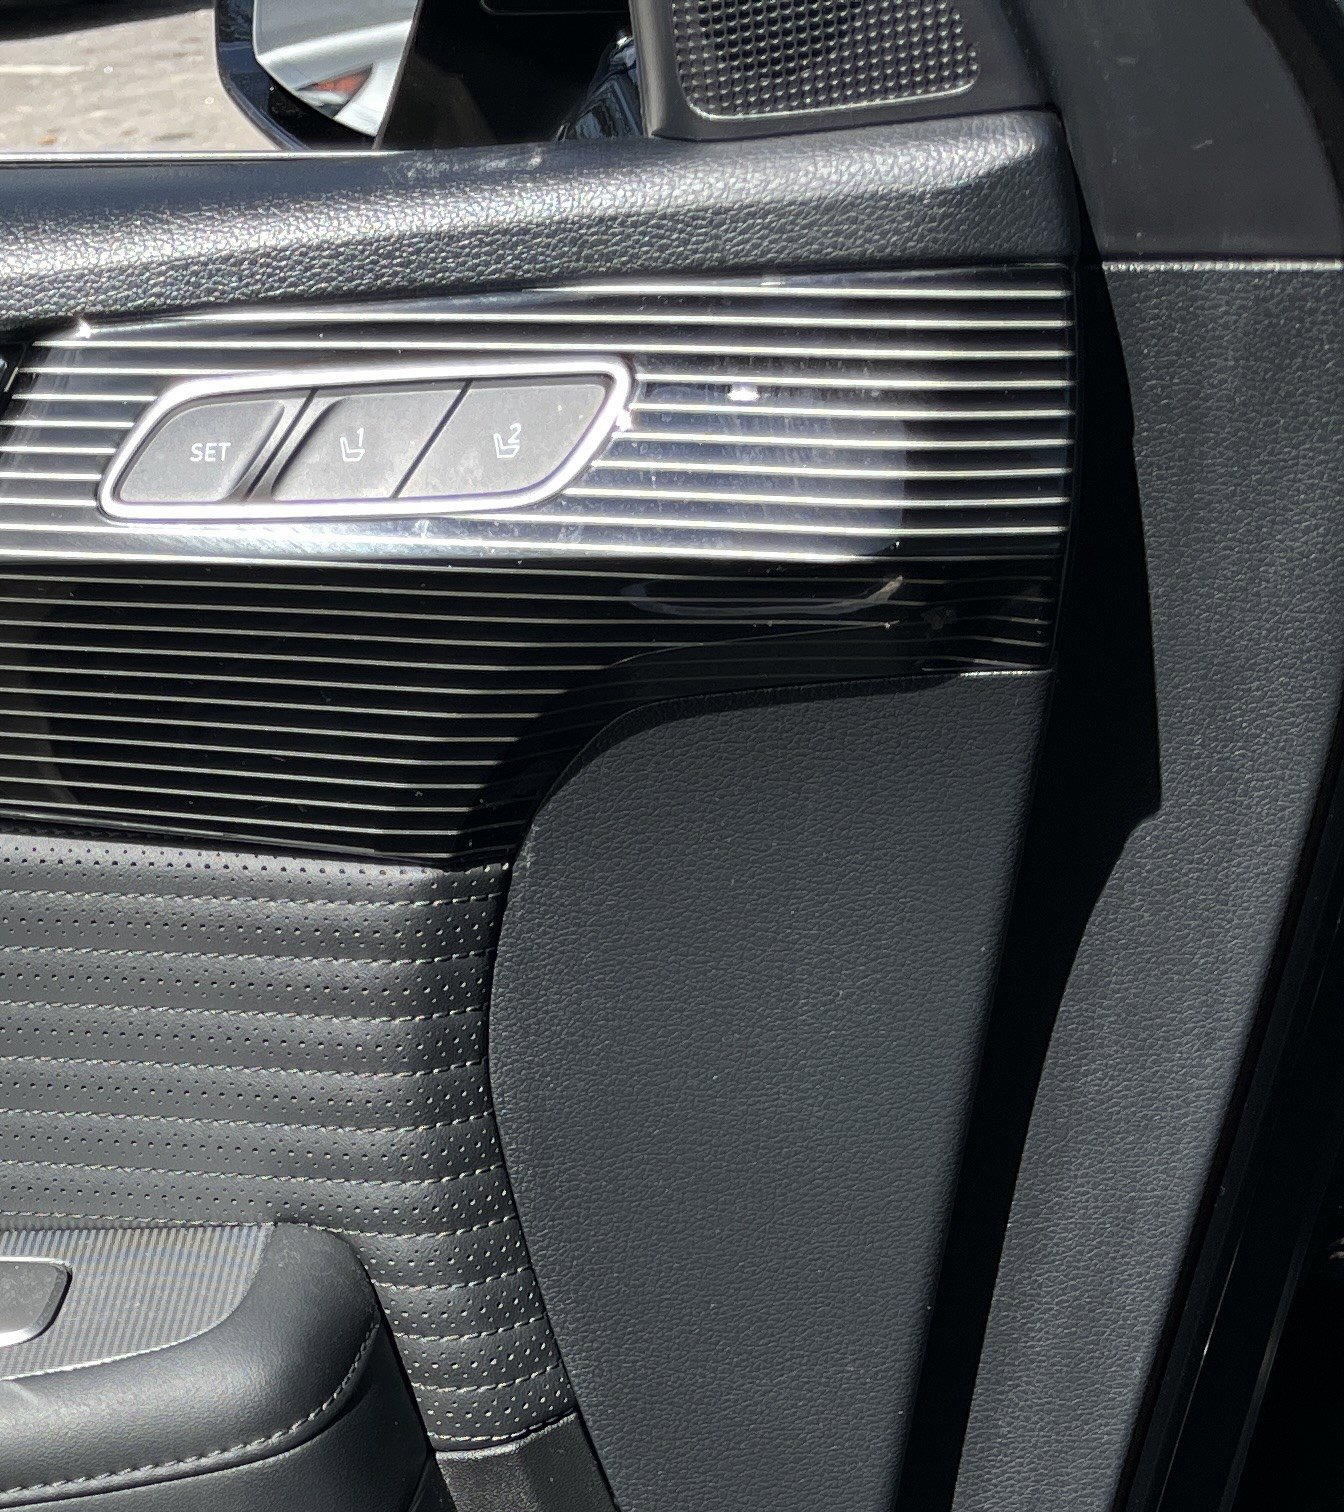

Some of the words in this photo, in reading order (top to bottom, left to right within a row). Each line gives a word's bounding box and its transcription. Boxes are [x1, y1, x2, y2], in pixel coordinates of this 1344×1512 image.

[356, 427, 364, 447] 1
[507, 422, 521, 443] 2
[190, 442, 231, 462] SET
